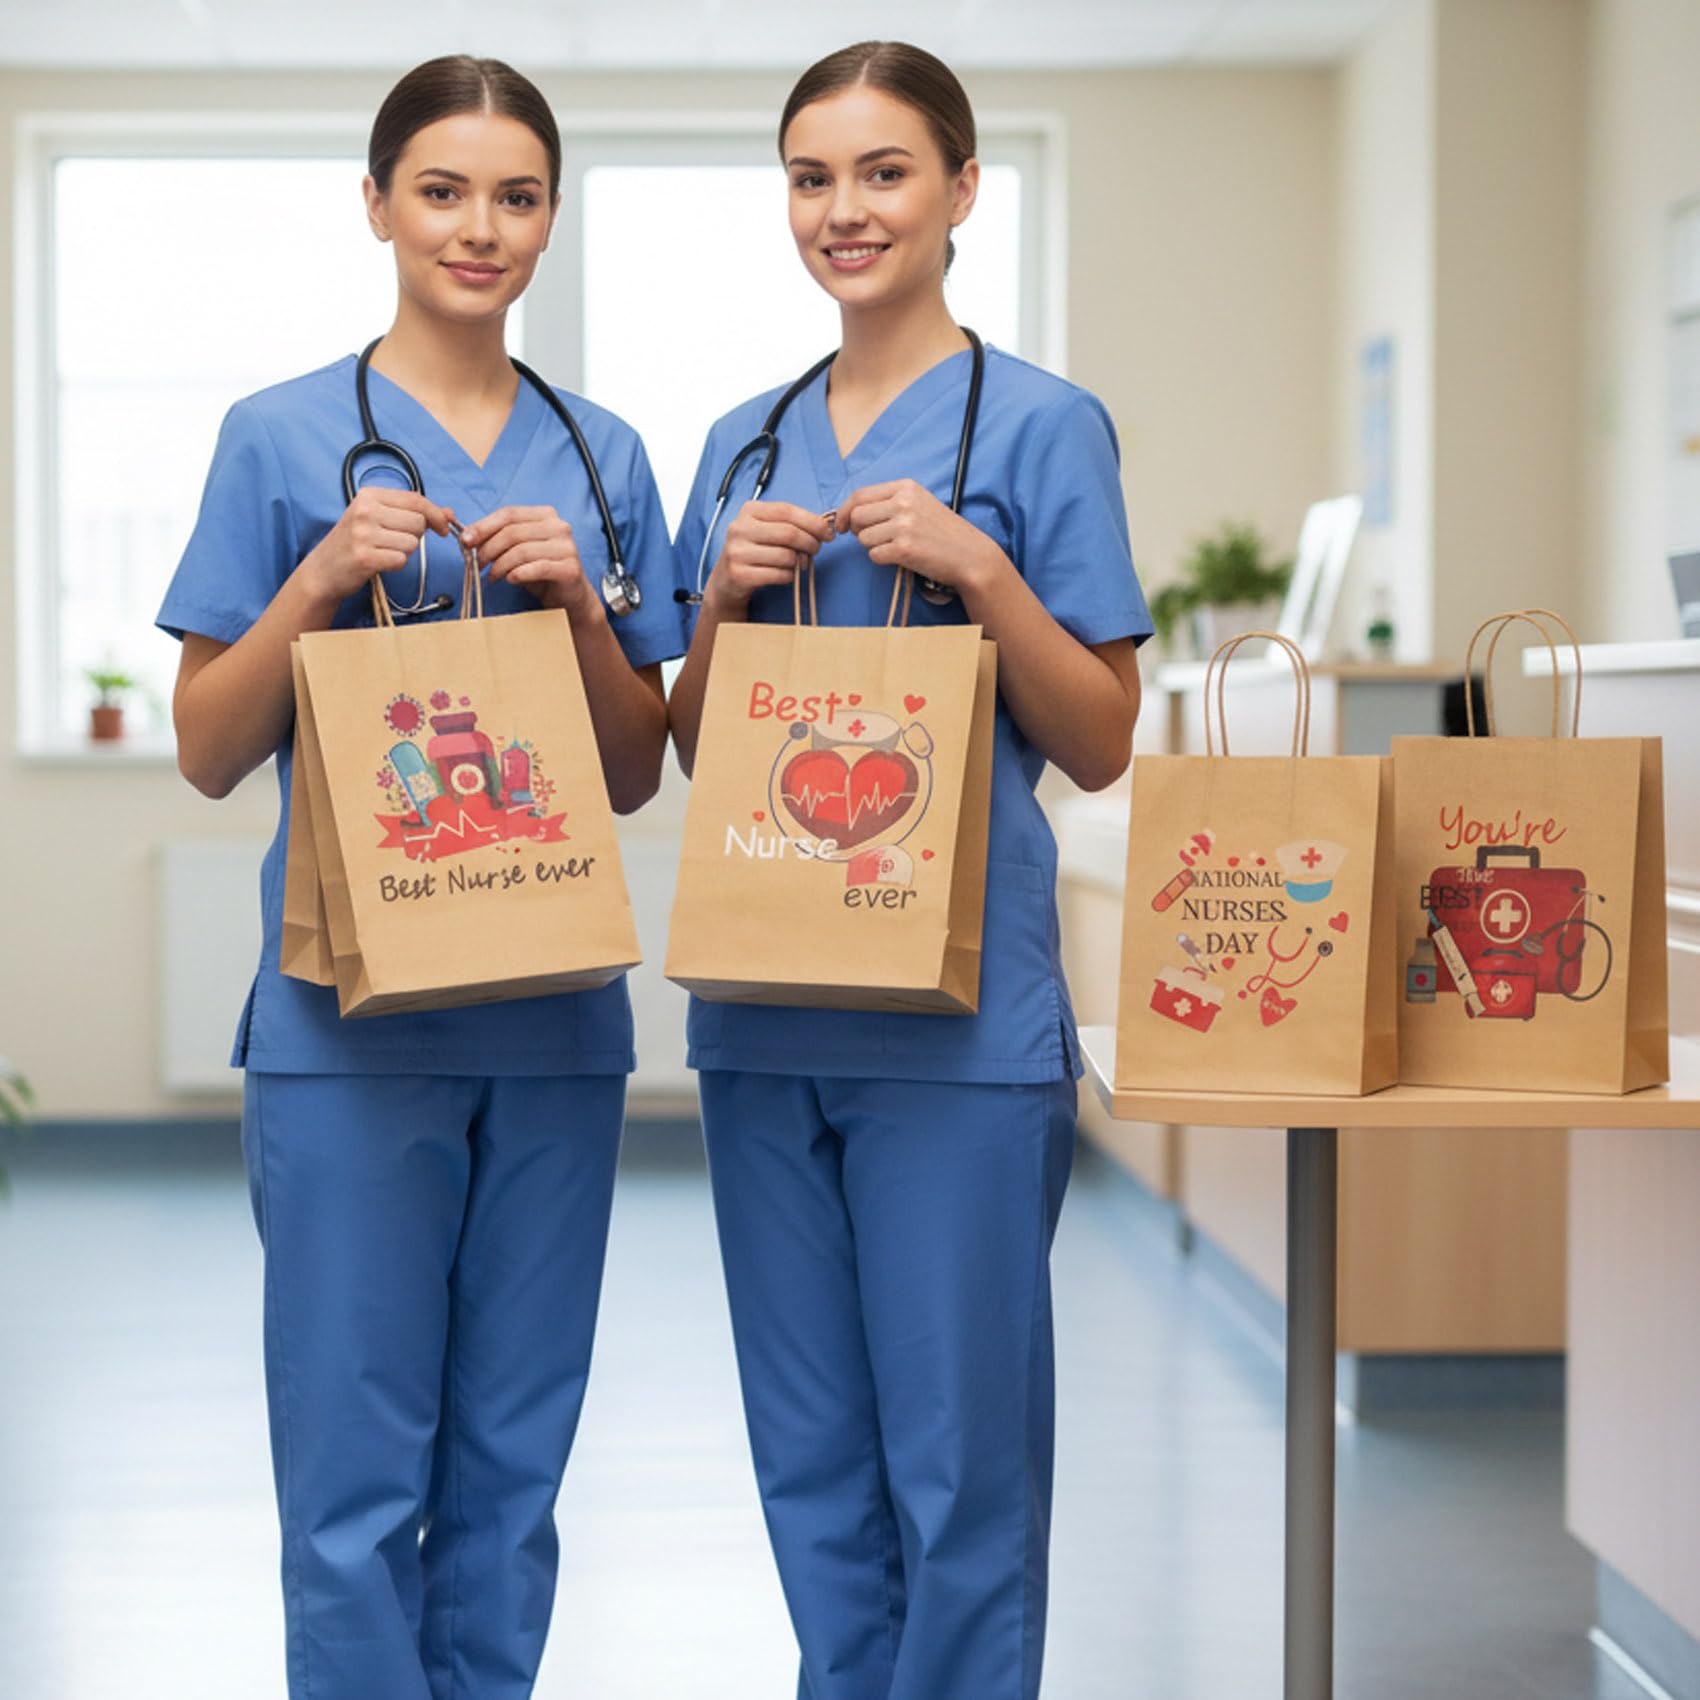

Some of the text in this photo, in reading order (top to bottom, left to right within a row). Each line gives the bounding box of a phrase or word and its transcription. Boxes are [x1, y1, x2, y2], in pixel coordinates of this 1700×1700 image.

[749, 681, 843, 725] Best
[724, 823, 838, 861] Nurse
[1440, 805, 1567, 850] You're
[379, 855, 596, 902] Best Nurse ever
[843, 887, 917, 910] ever
[1181, 898, 1288, 922] NURSES
[1205, 932, 1259, 955] DAY
